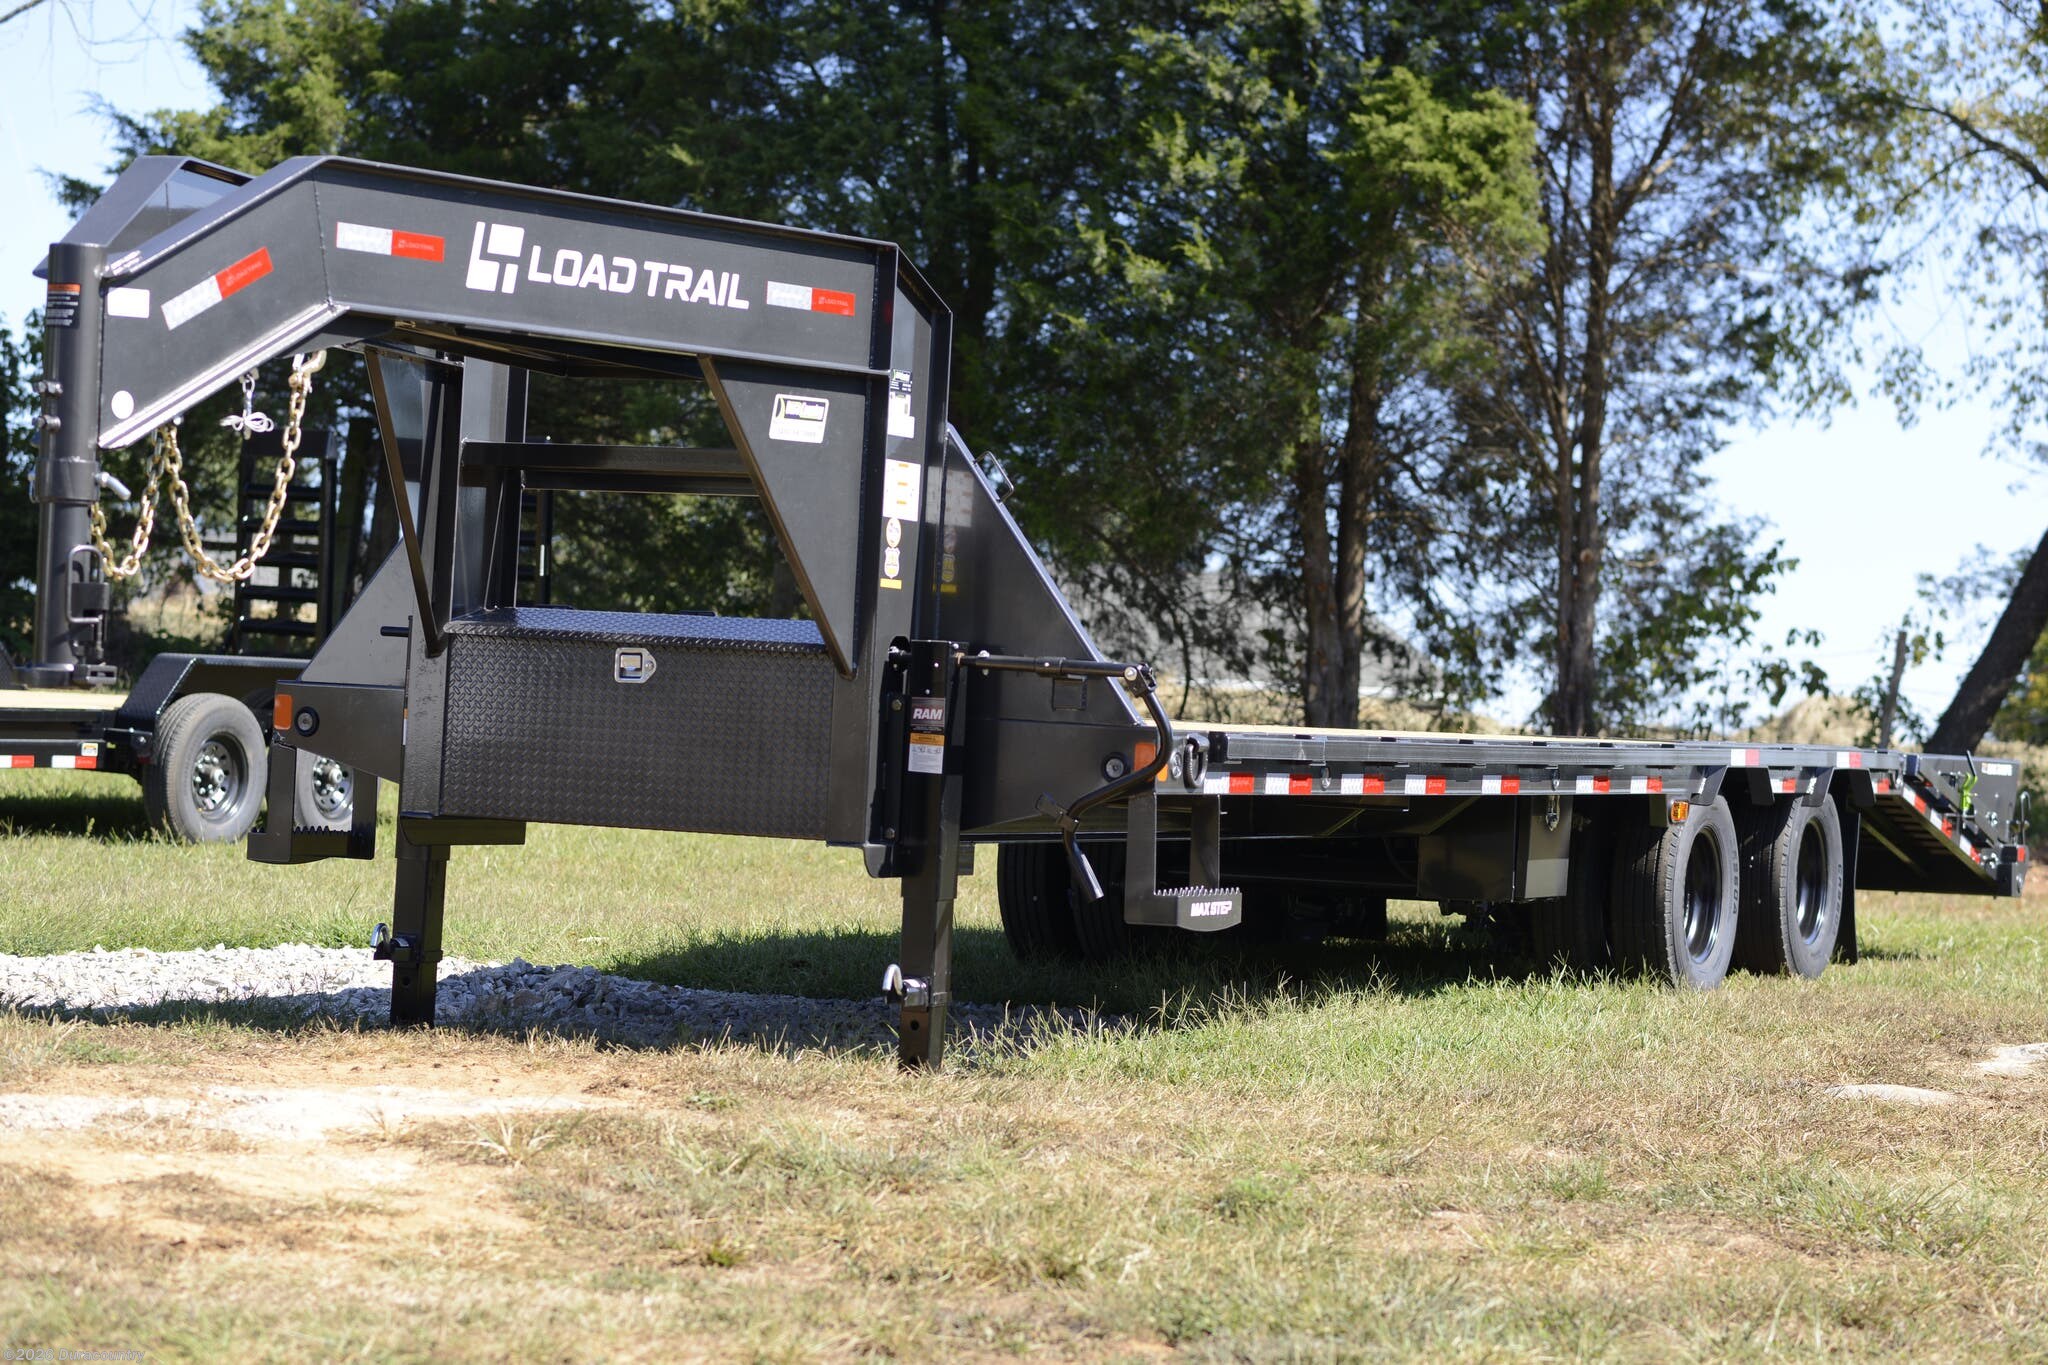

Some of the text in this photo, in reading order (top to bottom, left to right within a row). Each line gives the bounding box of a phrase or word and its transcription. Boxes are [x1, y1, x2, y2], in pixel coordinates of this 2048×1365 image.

[528, 245, 750, 310] LOAD TRAIL
[913, 708, 943, 720] RAM
[1190, 900, 1232, 917] MAX STEP
